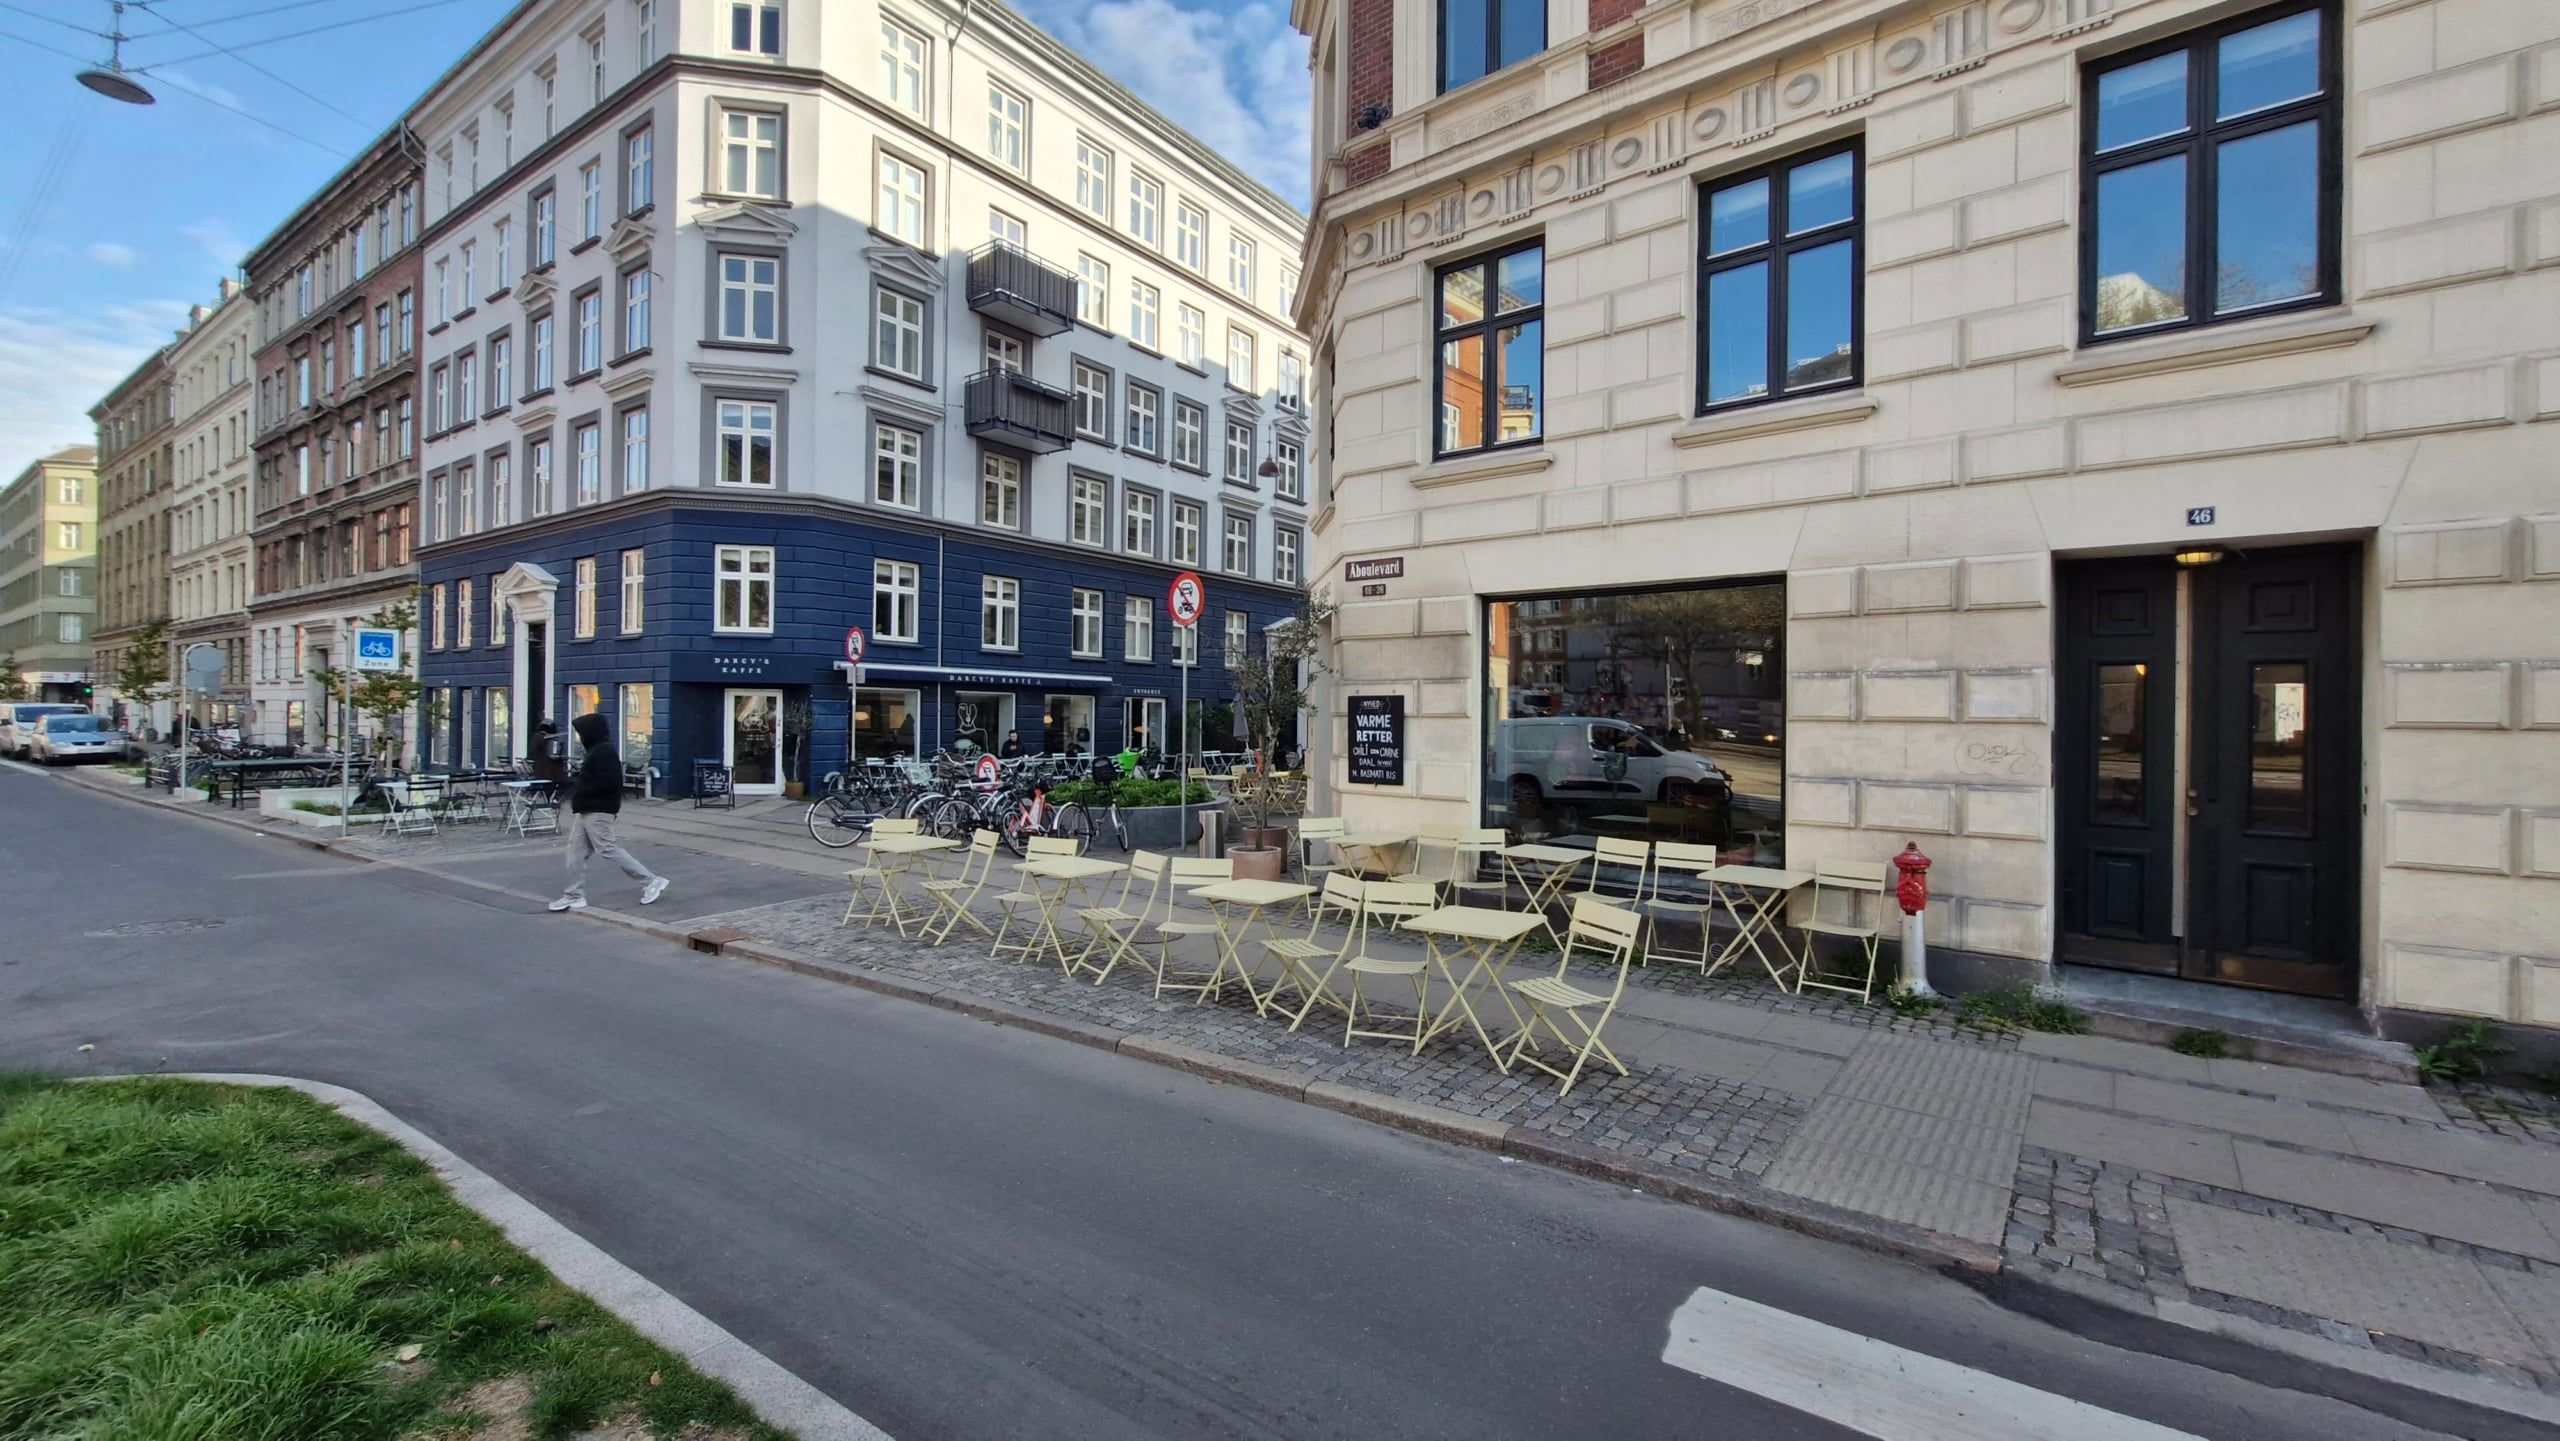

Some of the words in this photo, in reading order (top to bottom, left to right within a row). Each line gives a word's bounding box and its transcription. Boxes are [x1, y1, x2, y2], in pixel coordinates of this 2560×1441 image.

[2190, 508, 2212, 524] 46
[1349, 560, 1400, 579] Åboulevard
[714, 657, 770, 665] DARCY'S
[949, 674, 994, 683] DARCY'S
[1002, 677, 1031, 685] KAFFE
[1356, 714, 1392, 728] VARME
[1356, 730, 1393, 743] RETTER
[1379, 746, 1399, 759] CARNE
[1360, 769, 1384, 779] BASMATI
